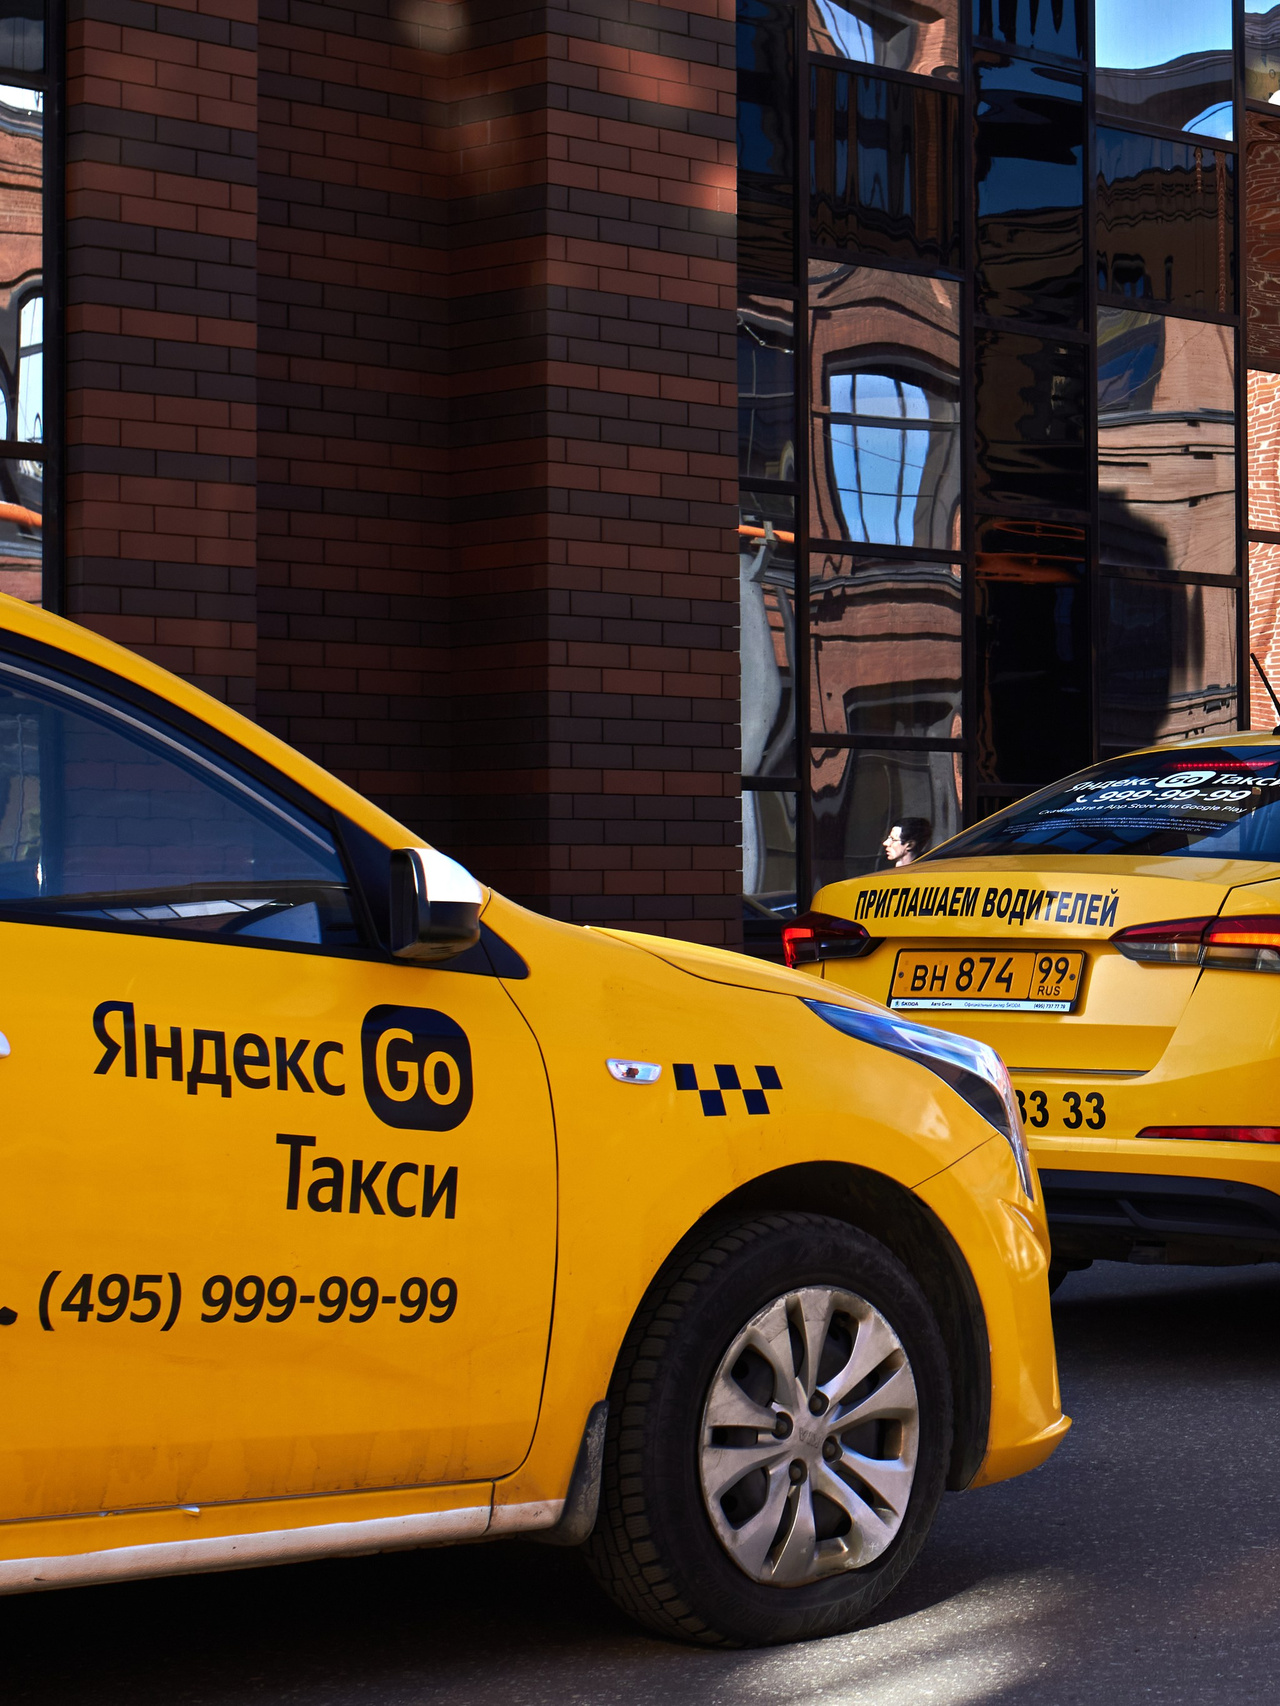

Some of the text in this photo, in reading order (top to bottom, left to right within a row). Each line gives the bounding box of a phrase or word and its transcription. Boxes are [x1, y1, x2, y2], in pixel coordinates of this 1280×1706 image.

[1064, 777, 1159, 793] Яндекс
[1092, 789, 1252, 802] 999-99-99
[1180, 803, 1221, 811] Google
[1221, 805, 1247, 813] Play
[854, 886, 1120, 927] ПРИГЛАШАЕМ ВОДИТЕЛЕЙ
[955, 957, 1014, 993] 874
[1038, 956, 1070, 984] 99
[1037, 985, 1061, 996] RUS
[92, 1000, 462, 1106] Яндекс Go
[1062, 1091, 1106, 1130] 33
[276, 1132, 459, 1220] Такси
[38, 1270, 458, 1332] (495) 999-99-99
